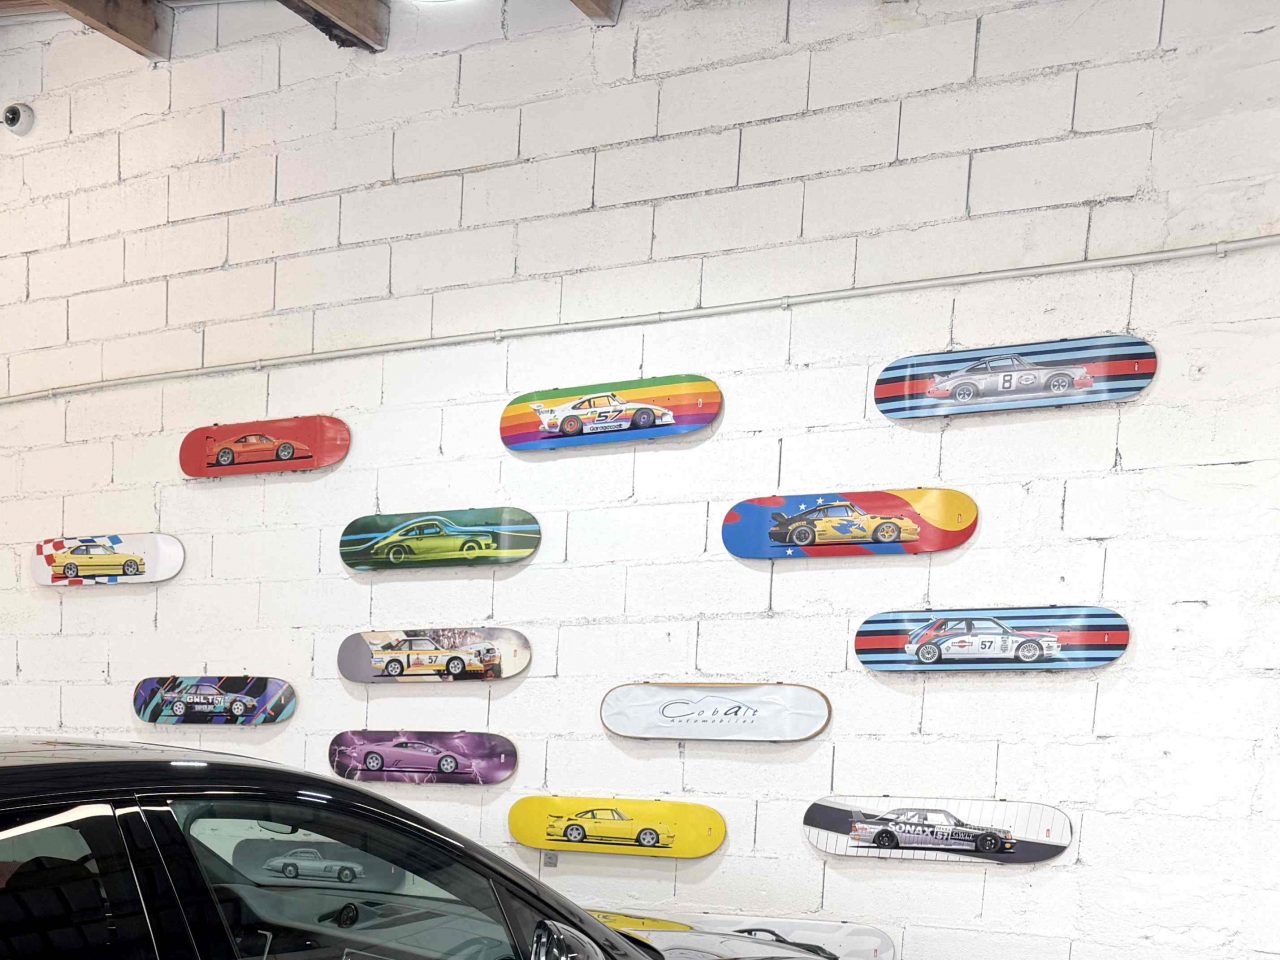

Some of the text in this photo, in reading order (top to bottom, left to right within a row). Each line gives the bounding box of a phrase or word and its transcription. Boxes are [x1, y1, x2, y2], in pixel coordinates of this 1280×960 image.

[1001, 373, 1013, 390] 8
[594, 409, 624, 422] 57
[980, 640, 993, 650] 57
[428, 655, 439, 664] 57
[661, 701, 759, 718] Cobalt
[887, 821, 935, 837] SONAX
[935, 830, 950, 840] 57
